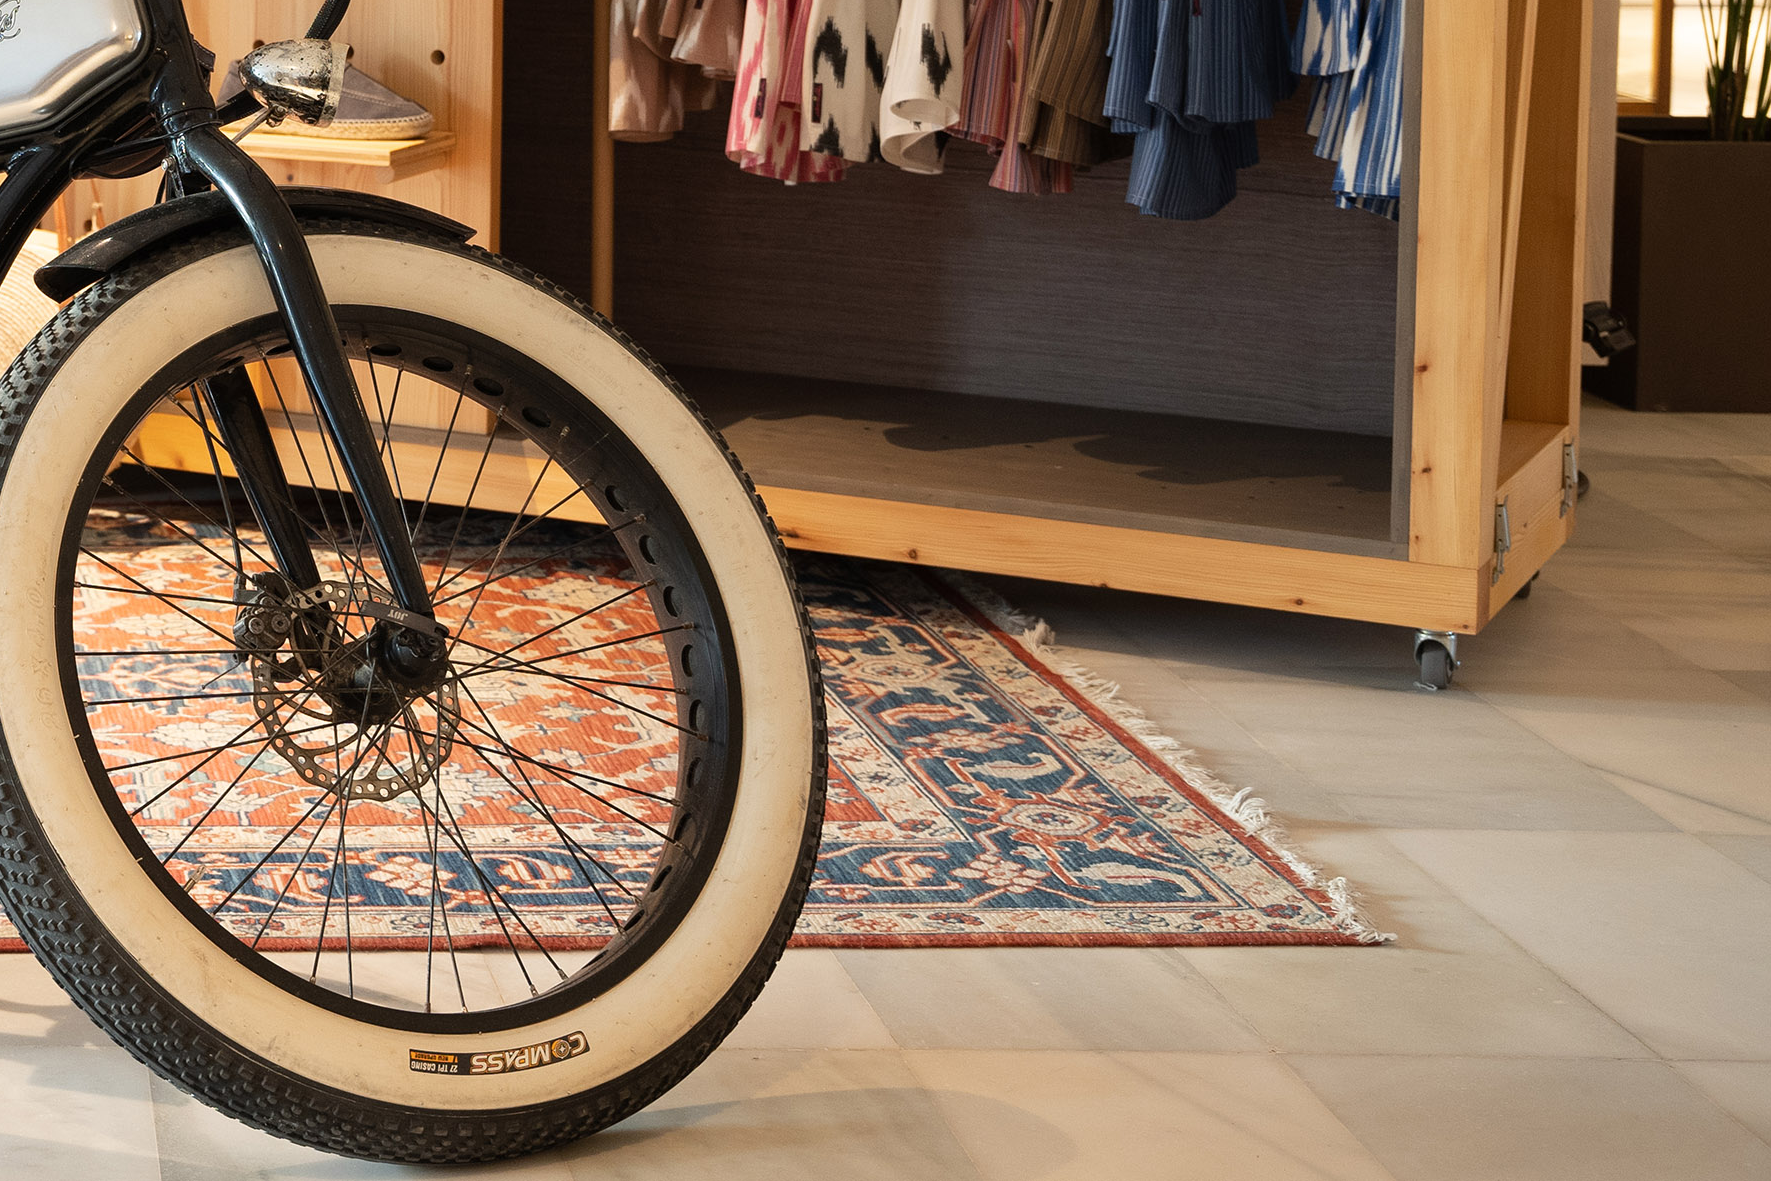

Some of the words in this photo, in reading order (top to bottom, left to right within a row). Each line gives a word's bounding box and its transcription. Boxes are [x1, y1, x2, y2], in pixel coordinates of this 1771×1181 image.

[470, 1033, 588, 1074] COMPASS
[410, 1060, 436, 1071] CASING
[437, 1063, 449, 1073] TPI
[450, 1064, 458, 1073] 27
